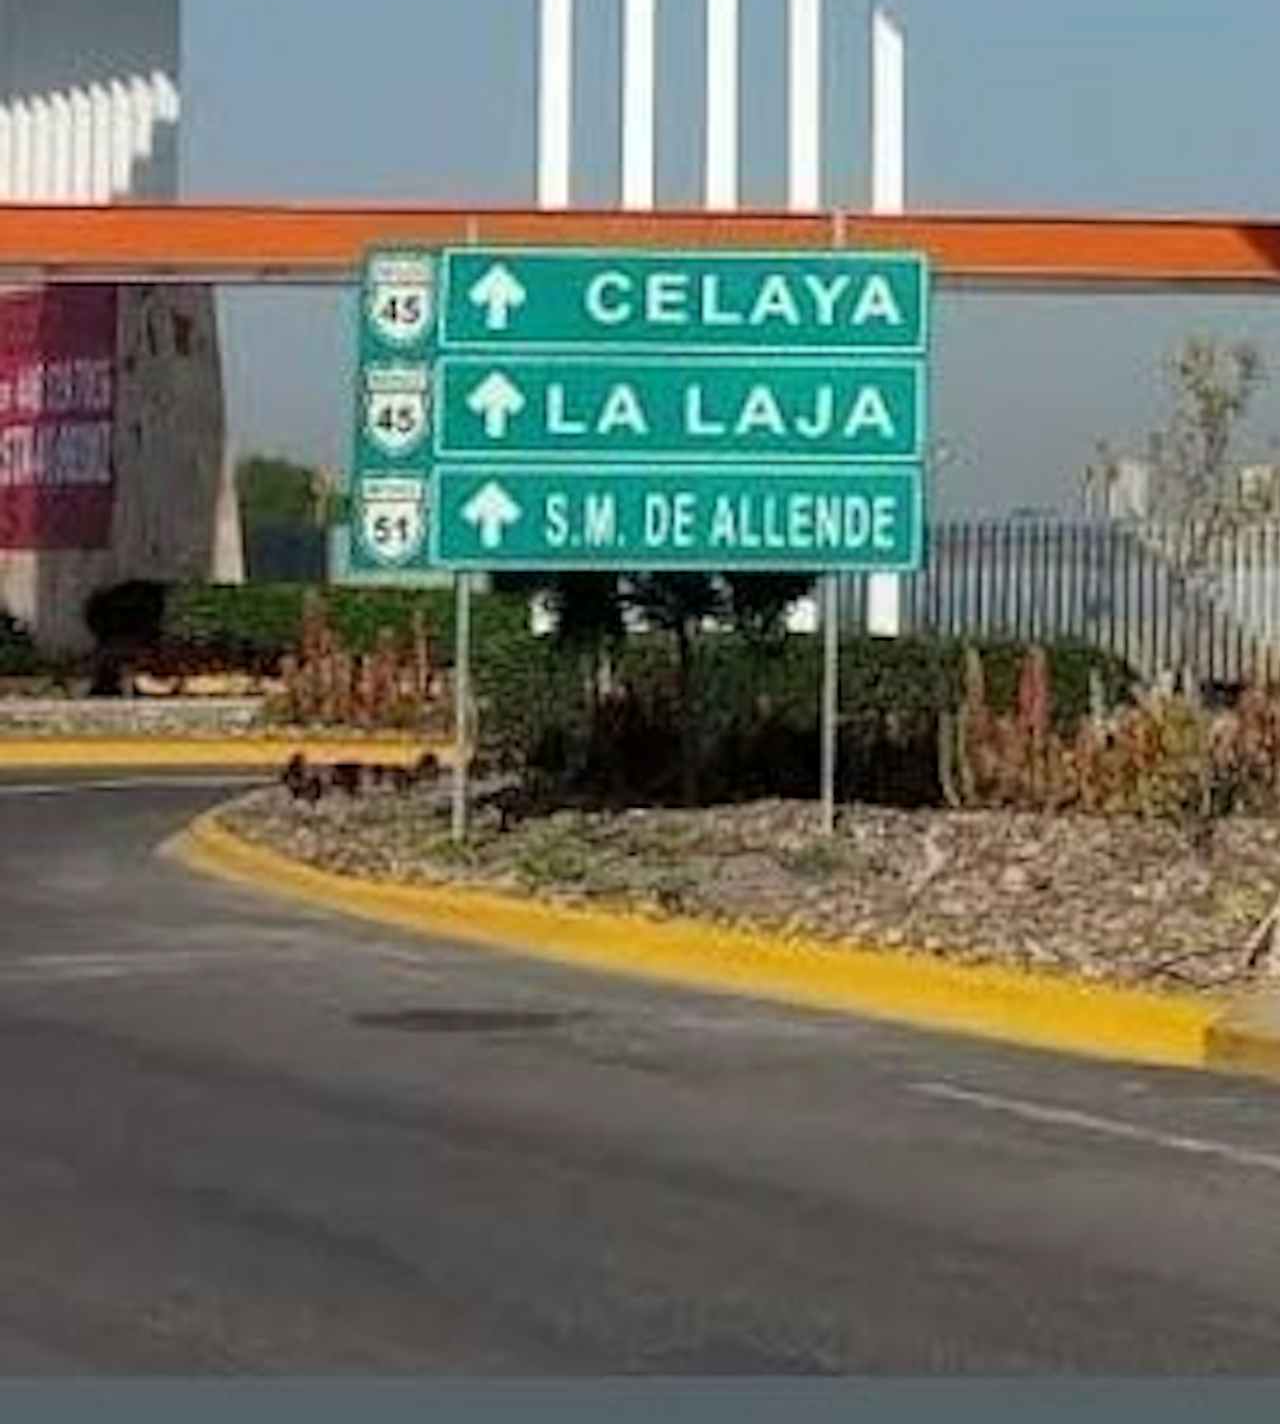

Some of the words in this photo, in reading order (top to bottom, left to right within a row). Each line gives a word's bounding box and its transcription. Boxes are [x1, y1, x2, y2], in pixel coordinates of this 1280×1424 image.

[381, 295, 421, 325] 45
[584, 272, 900, 326] CELAYA
[545, 384, 647, 435] LA
[685, 384, 896, 439] LAJA
[375, 515, 409, 544] 51
[545, 492, 626, 548] S.M.
[645, 494, 699, 548] DE
[709, 495, 897, 549] ALLENDE
